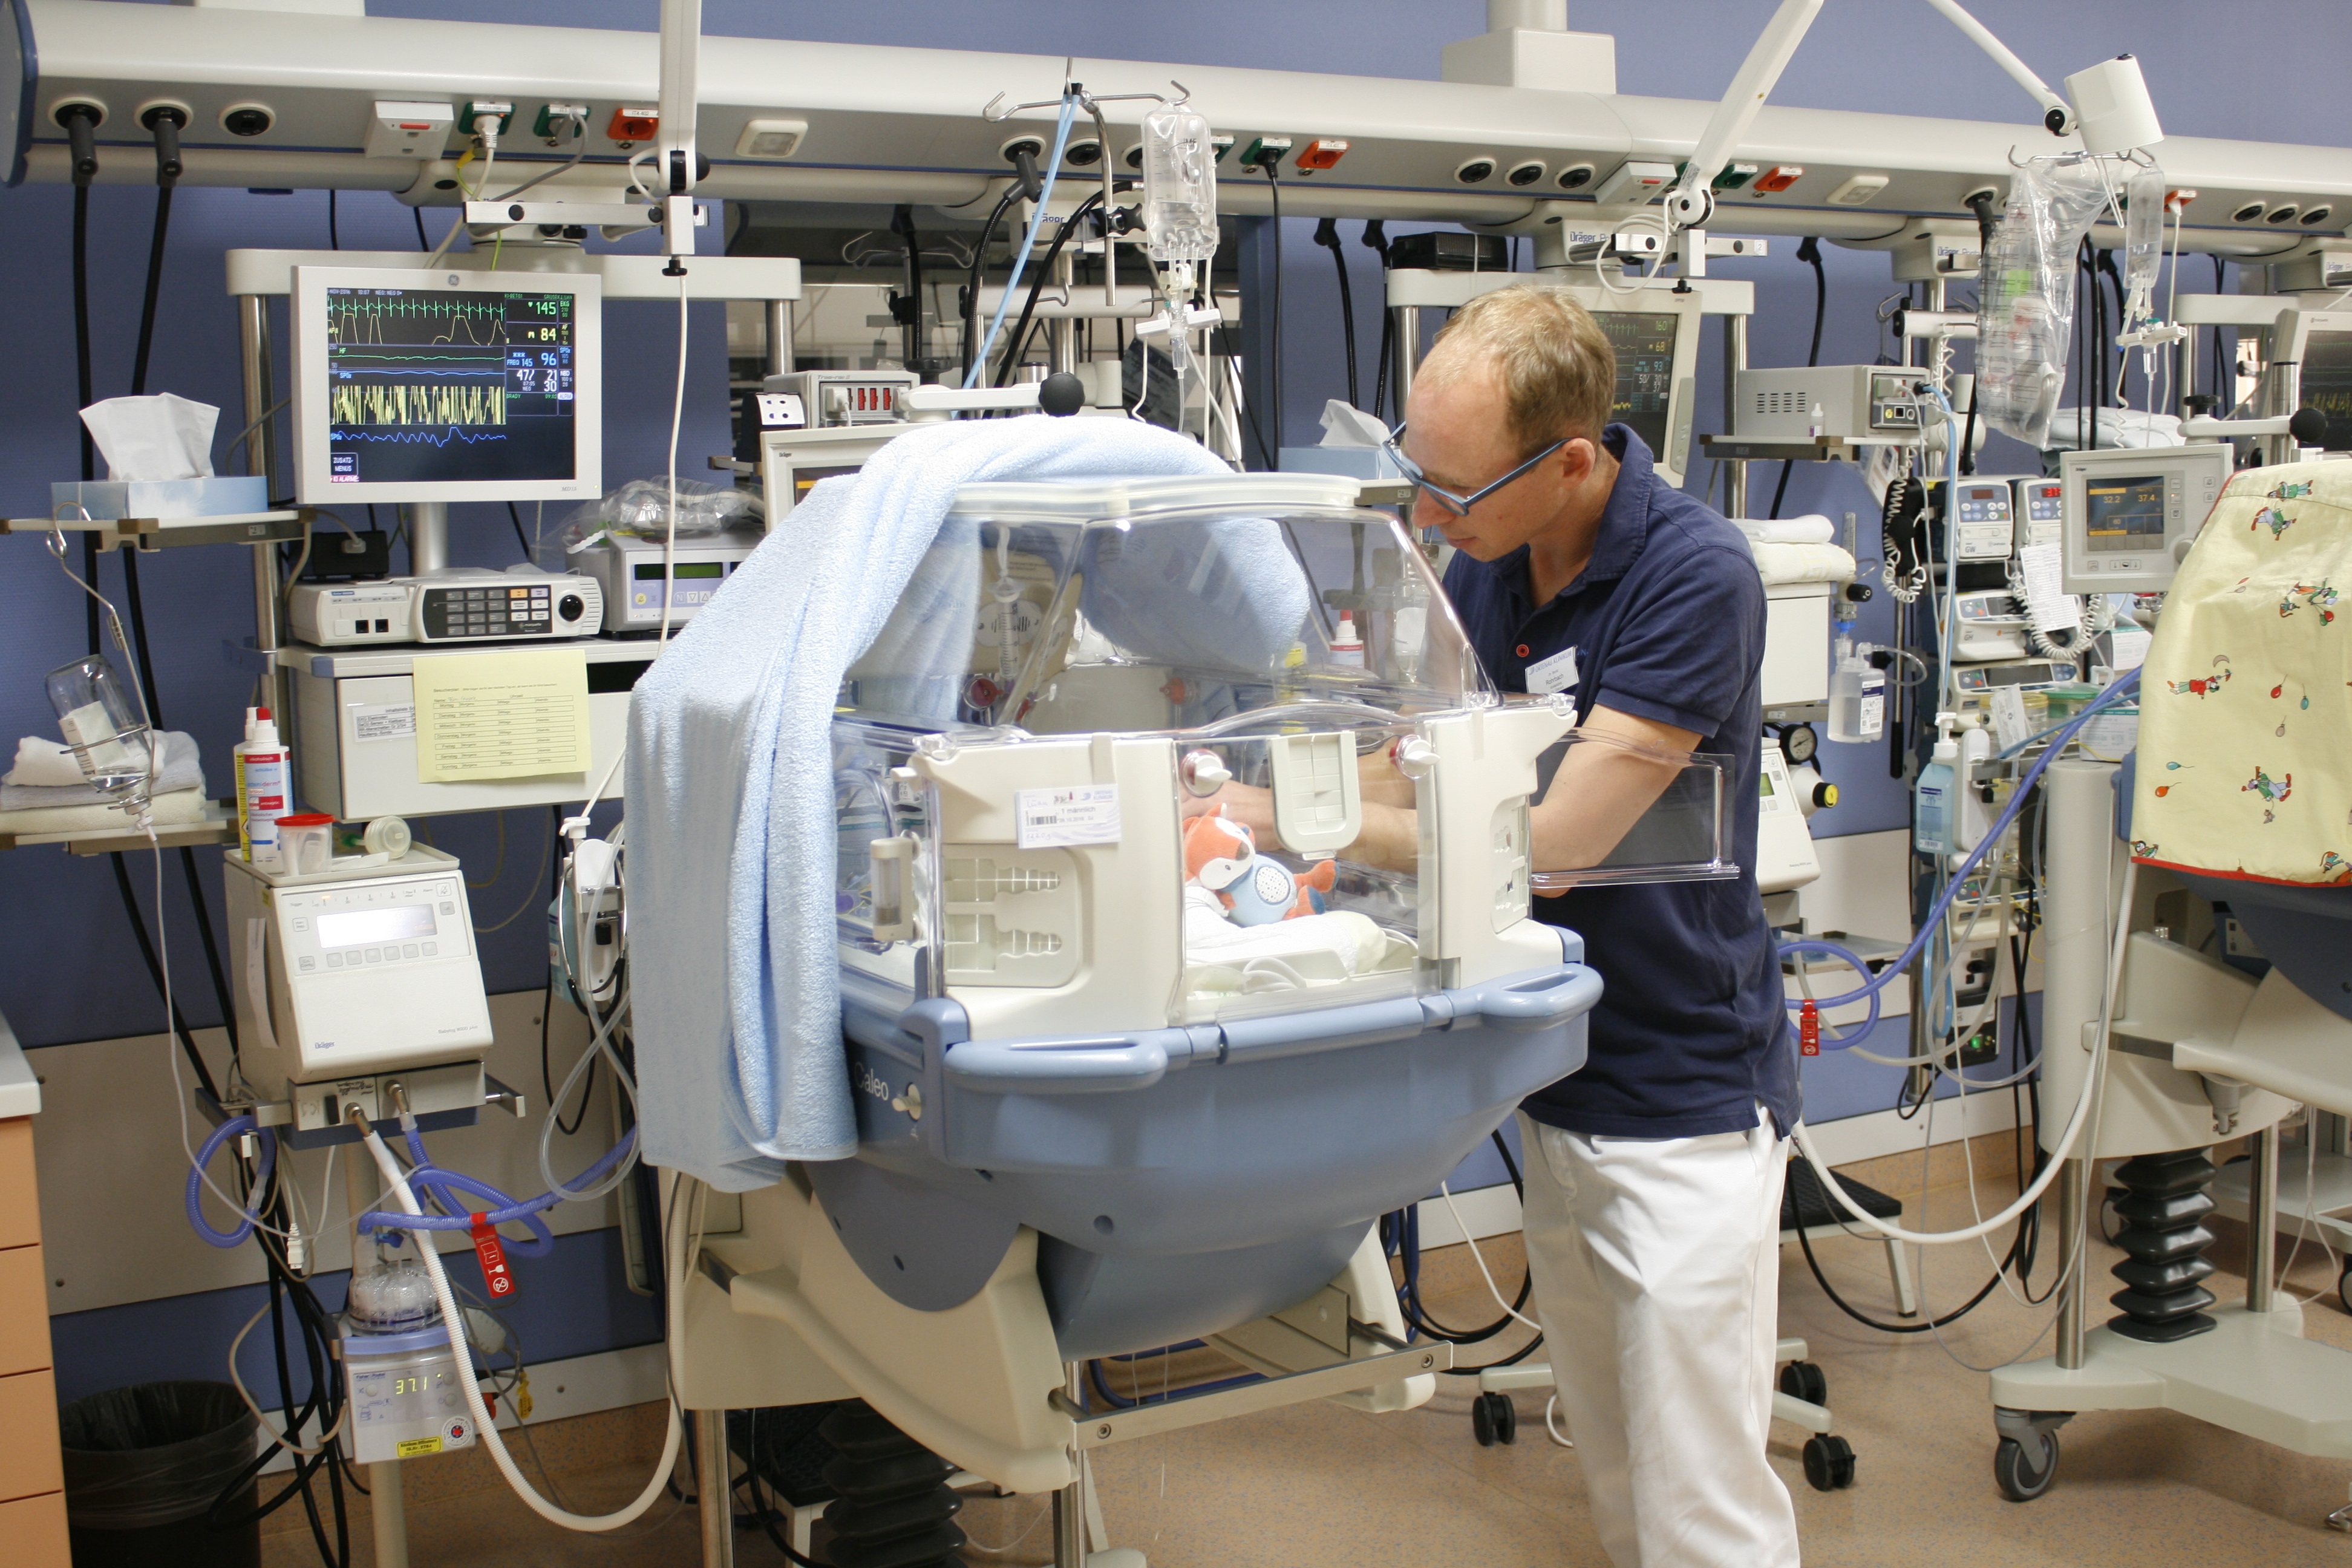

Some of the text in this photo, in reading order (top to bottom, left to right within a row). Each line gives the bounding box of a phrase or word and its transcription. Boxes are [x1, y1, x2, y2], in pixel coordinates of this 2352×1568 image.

[1570, 231, 1596, 244] Dräger
[535, 301, 557, 315] 145
[1656, 320, 1667, 331] 160
[540, 327, 557, 342] 84
[1655, 341, 1665, 352] 68
[521, 358, 533, 367] 145
[540, 353, 557, 366] 96
[1654, 361, 1663, 371] 93
[547, 370, 557, 381] 21
[544, 381, 557, 392] 30
[315, 1041, 335, 1050] Dräger
[854, 1061, 889, 1101] Caleo
